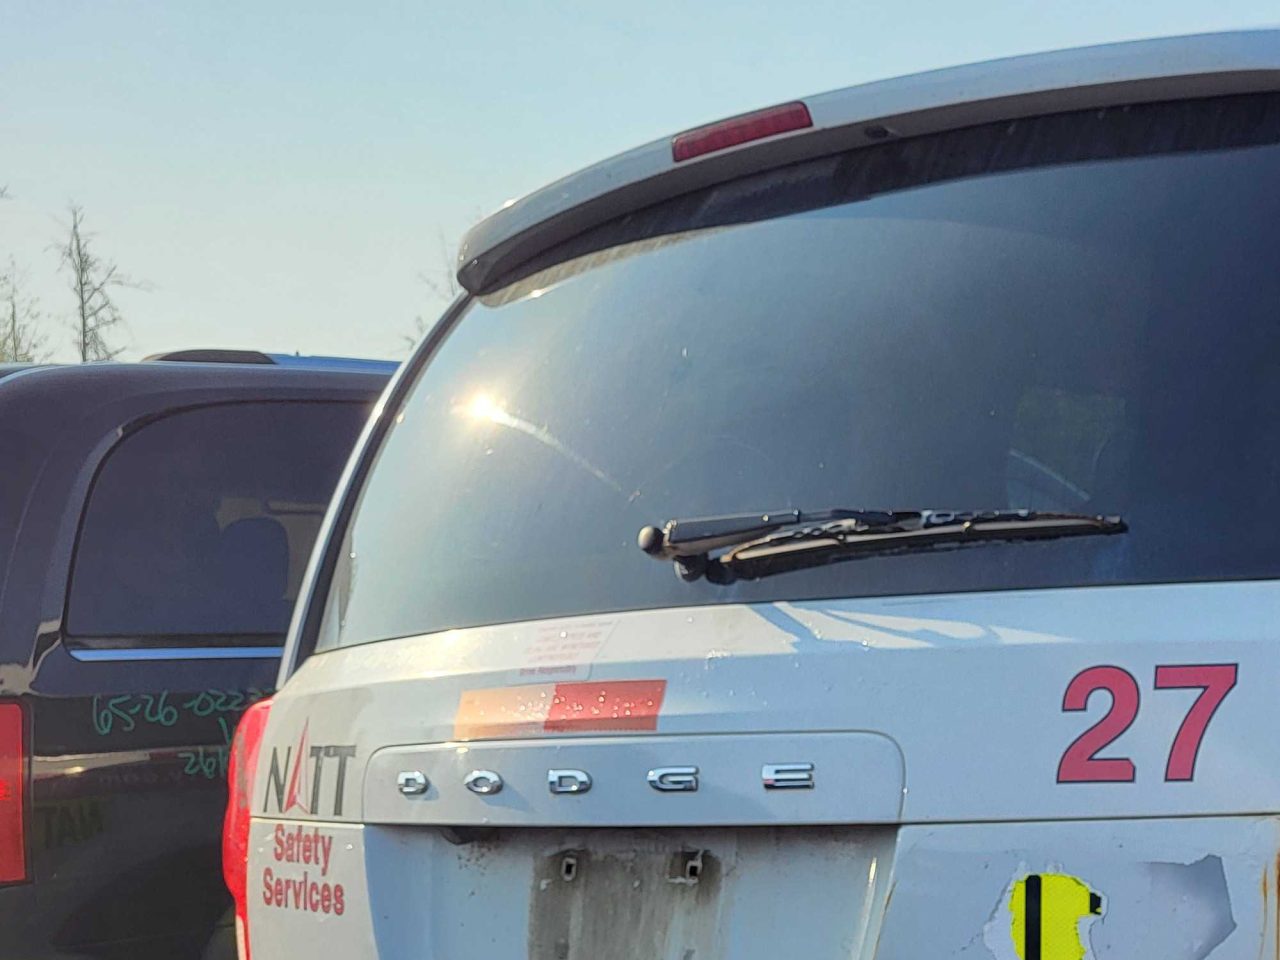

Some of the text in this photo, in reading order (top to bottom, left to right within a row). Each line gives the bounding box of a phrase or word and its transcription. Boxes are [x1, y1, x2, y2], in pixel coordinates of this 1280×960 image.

[1056, 663, 1239, 784] 27
[263, 716, 357, 816] NATT
[397, 763, 815, 795] DODGE
[274, 823, 334, 876] Safety
[263, 867, 345, 916] Services
